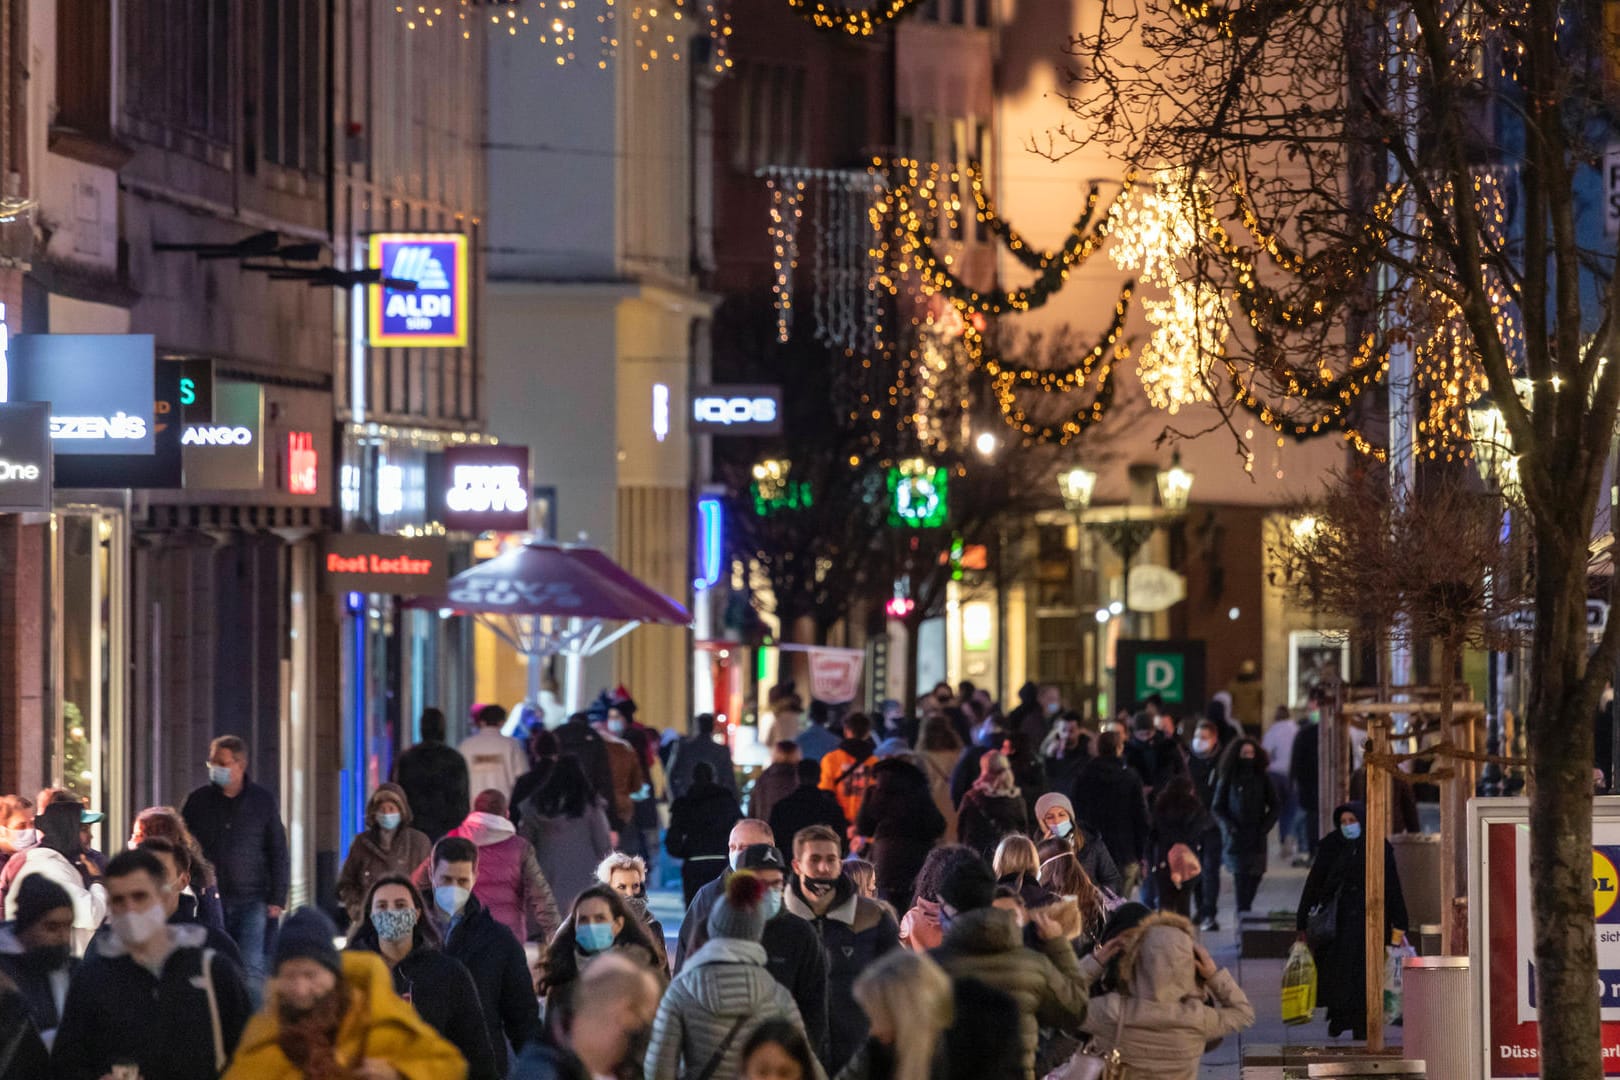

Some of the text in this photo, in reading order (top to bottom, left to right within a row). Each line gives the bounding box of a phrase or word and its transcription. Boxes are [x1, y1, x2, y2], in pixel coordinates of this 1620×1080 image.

[386, 294, 451, 317] ALDI
[694, 398, 776, 424] IQOS
[181, 426, 252, 445] ANGO
[1145, 659, 1175, 689] D
